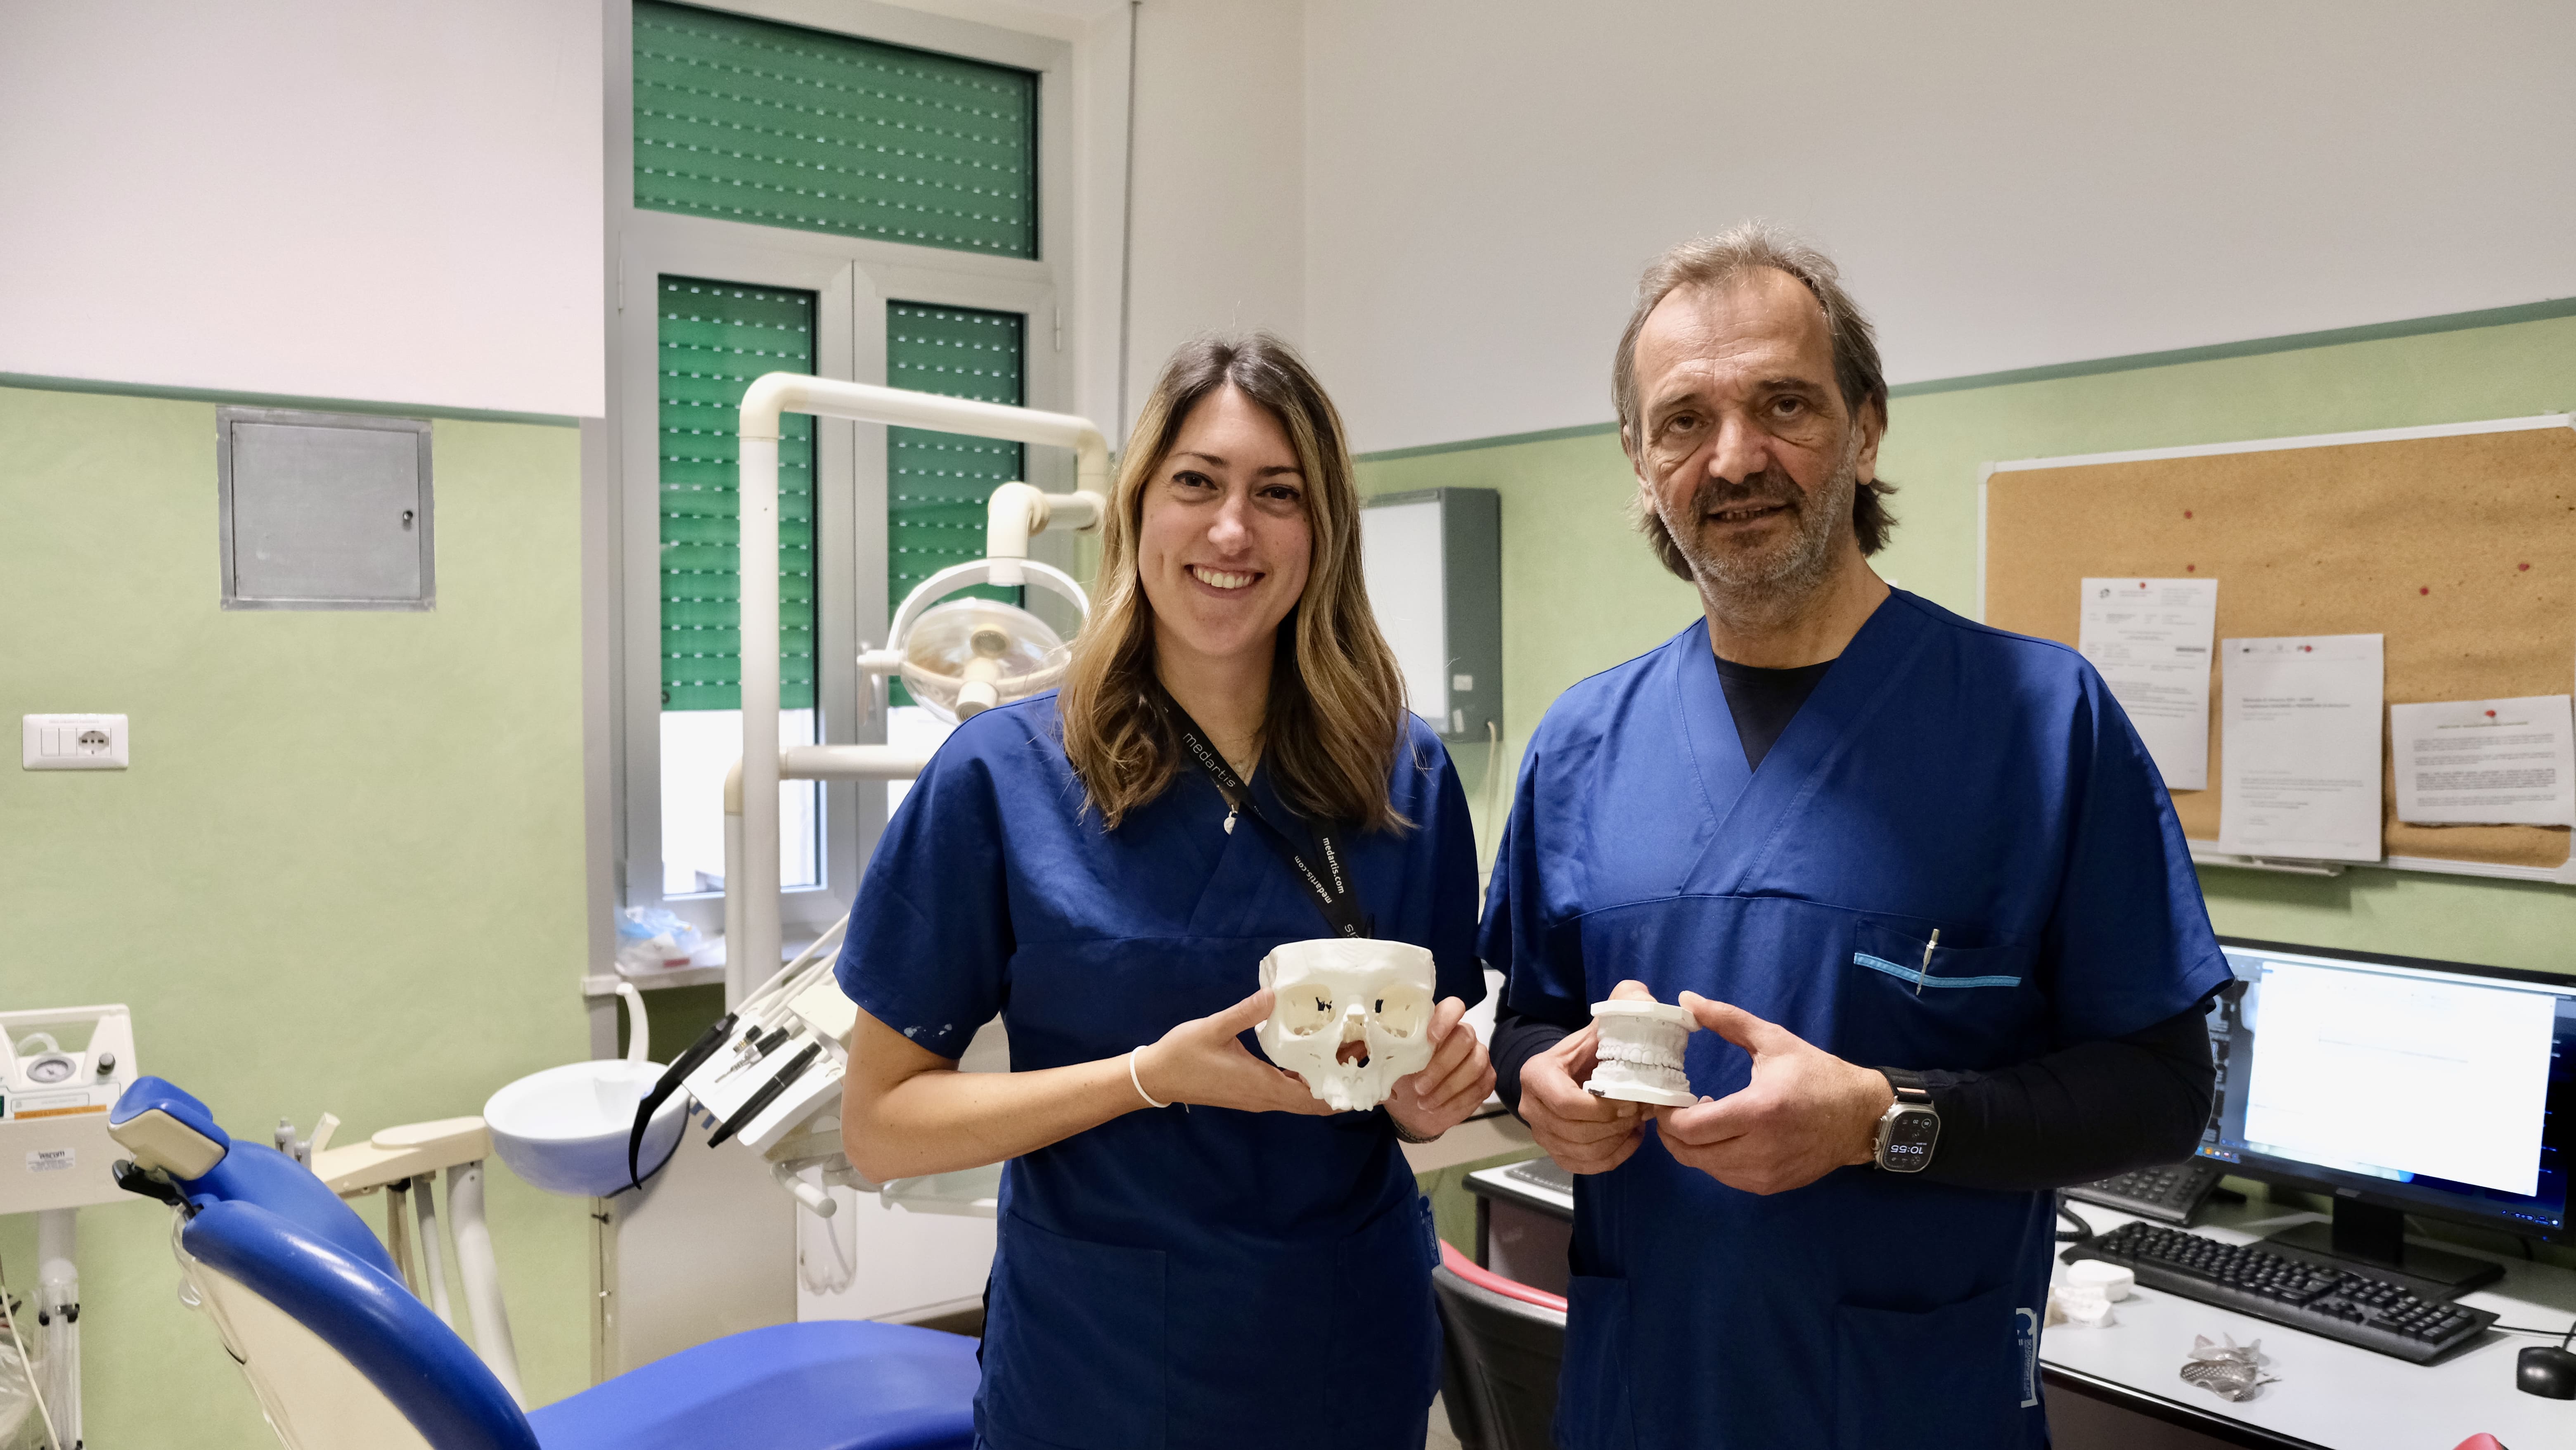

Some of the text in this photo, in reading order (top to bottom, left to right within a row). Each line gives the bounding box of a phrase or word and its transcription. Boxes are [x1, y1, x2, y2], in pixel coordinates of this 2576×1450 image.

[1183, 732, 1235, 788] medartis
[1295, 855, 1332, 904] medartis.com
[1323, 837, 1344, 894] medartis.com
[1891, 1145, 1923, 1154] 10:55
